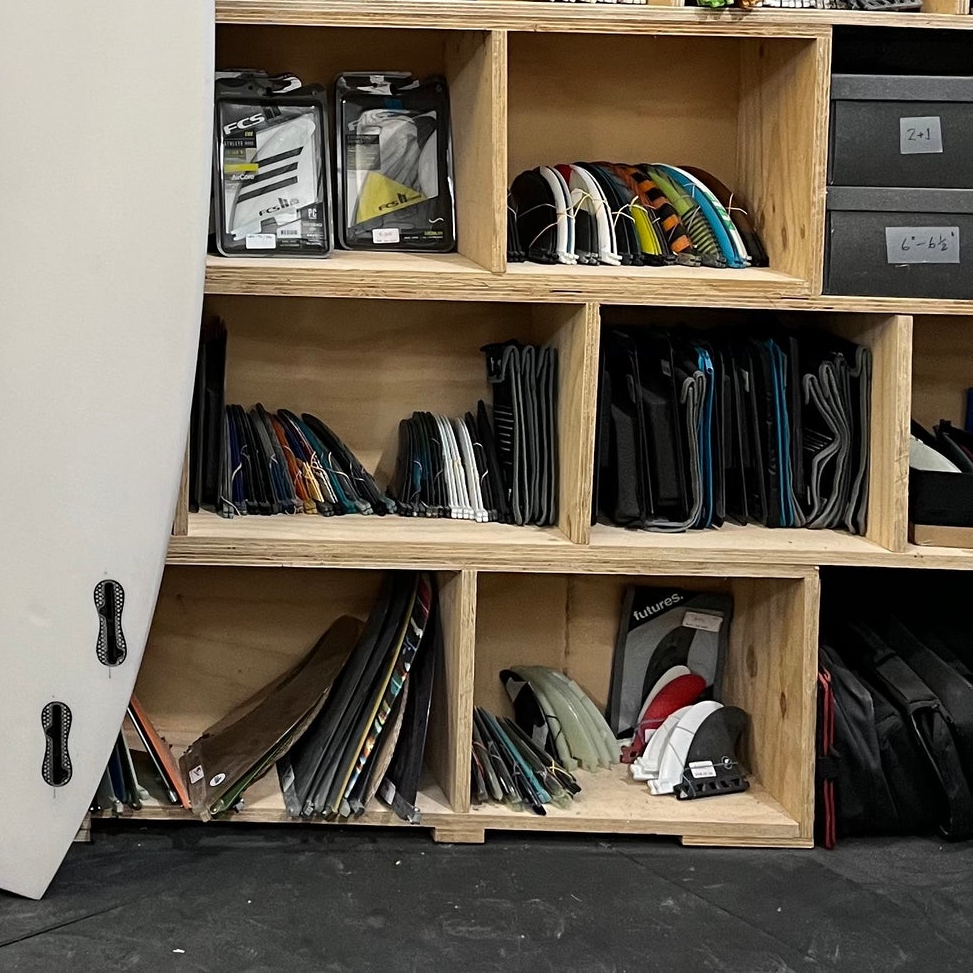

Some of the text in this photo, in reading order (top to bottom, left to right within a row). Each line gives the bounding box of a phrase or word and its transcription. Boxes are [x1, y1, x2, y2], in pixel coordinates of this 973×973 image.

[222, 112, 267, 135] FCS
[906, 127, 931, 142] 2+1
[258, 206, 280, 218] FCS
[307, 207, 317, 217] PC
[378, 200, 399, 212] FCS
[632, 593, 684, 621] futures.
